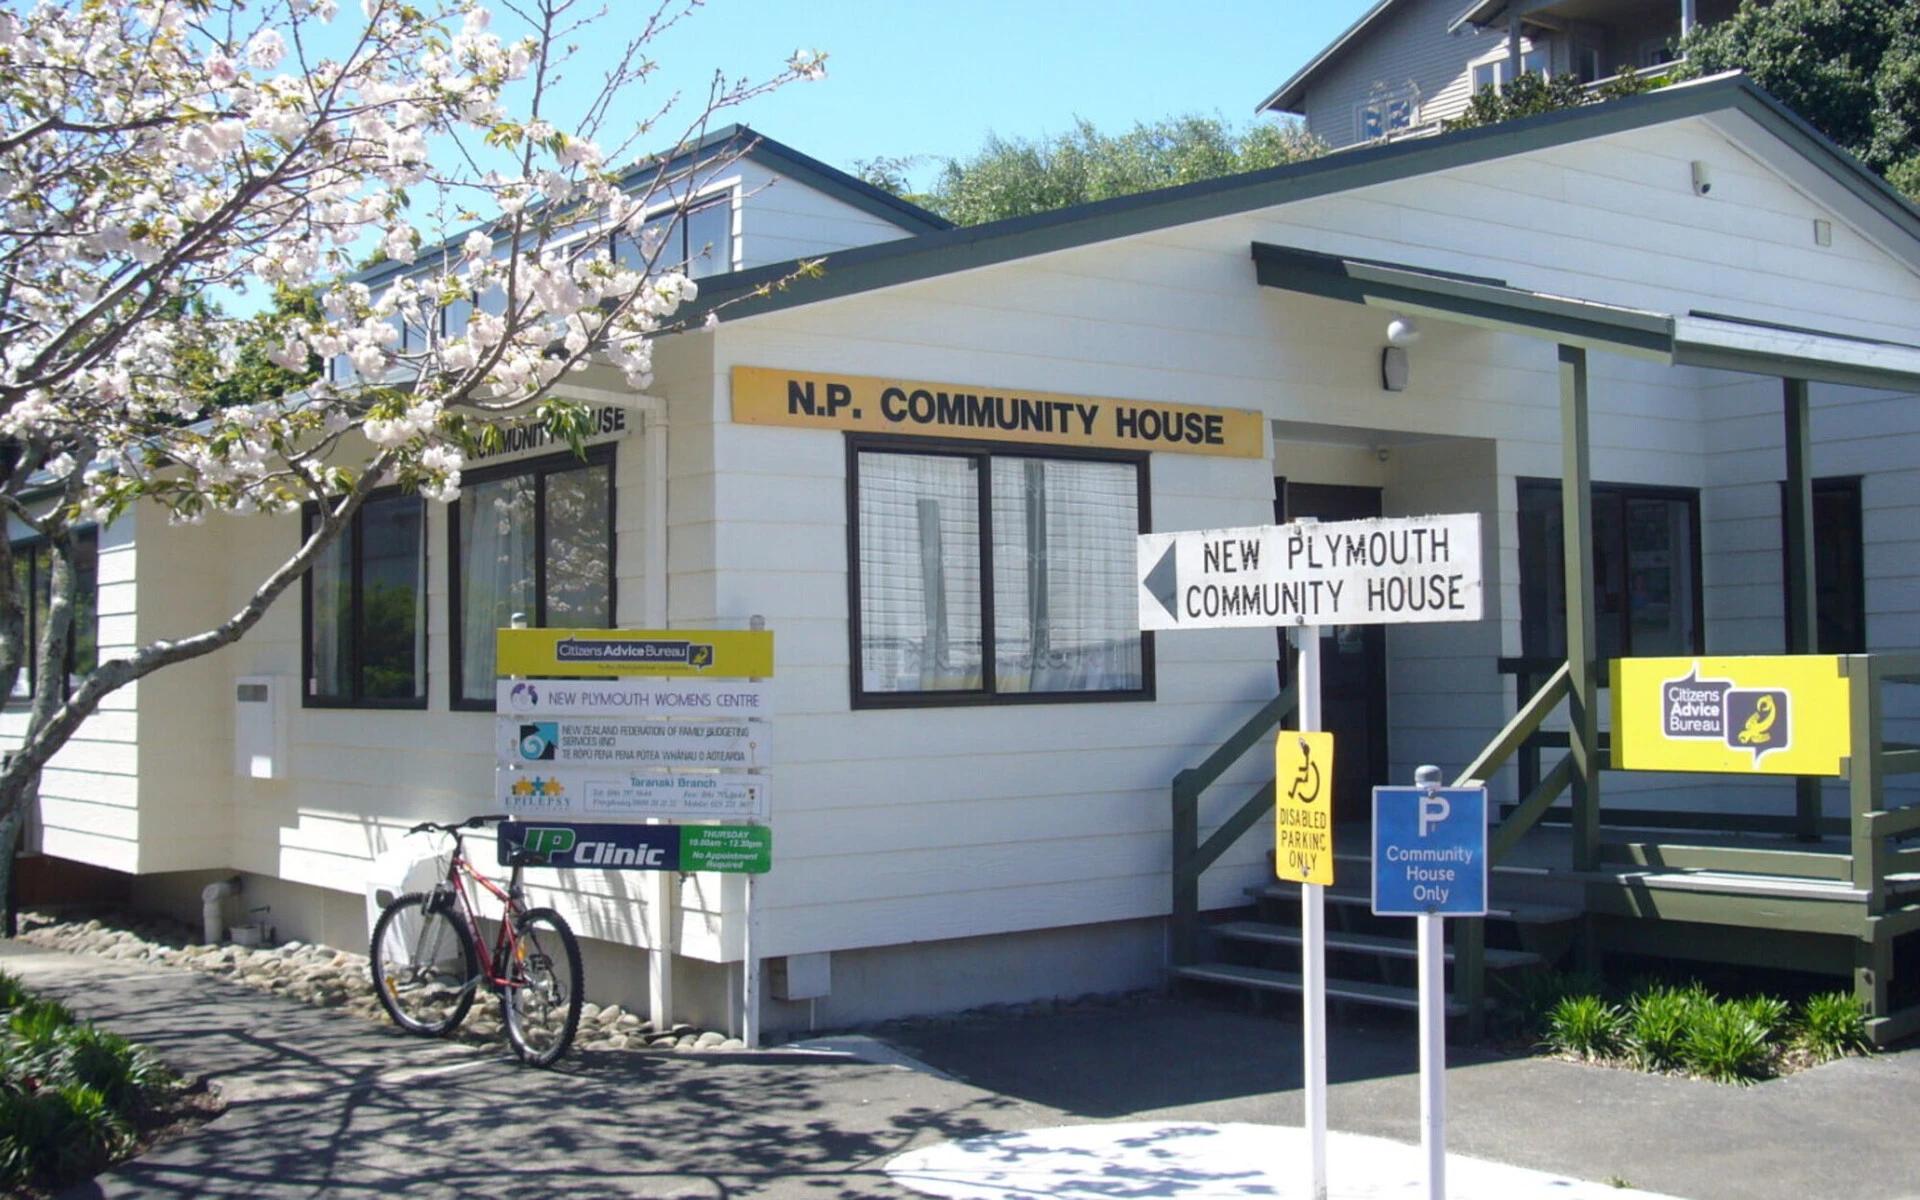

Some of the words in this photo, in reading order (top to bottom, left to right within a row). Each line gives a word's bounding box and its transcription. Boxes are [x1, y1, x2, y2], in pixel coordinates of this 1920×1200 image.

[787, 380, 862, 420] N.P.
[880, 386, 1099, 435] COMMUNITY
[1116, 407, 1225, 445] HOUSE
[1203, 539, 1260, 573] NEW
[1288, 528, 1449, 570] PLYMOUTH
[1187, 580, 1344, 618] COMMUNITY
[1367, 573, 1465, 612] HOUSE
[559, 644, 602, 657] Citizens
[603, 644, 644, 657] Advice
[645, 644, 685, 657] Bureau
[549, 692, 576, 706] NEW
[582, 692, 649, 707] PLYMOUTH
[655, 692, 711, 708] WOMENS
[716, 694, 760, 708] CENTRE
[1668, 687, 1720, 702] Citizens
[1670, 702, 1720, 717] Advice
[562, 725, 581, 736] NEW
[583, 725, 618, 736] ZEALAND
[620, 725, 666, 737] FEDERATION
[667, 726, 678, 737] OF
[679, 726, 705, 737] FAMILY
[705, 726, 750, 738] BUDGETING
[1669, 717, 1721, 732] Bureau
[630, 777, 674, 788] Taranaki
[678, 778, 717, 789] Branch
[1279, 807, 1327, 830] DISABLED
[1418, 797, 1450, 837] P
[703, 830, 750, 839] THURSDAY
[1281, 830, 1327, 852] PARKING
[573, 841, 665, 866] Clinic
[1289, 850, 1318, 871] ONLY
[1387, 845, 1473, 865] Community
[1406, 866, 1455, 881] House
[1413, 884, 1450, 904] Only
